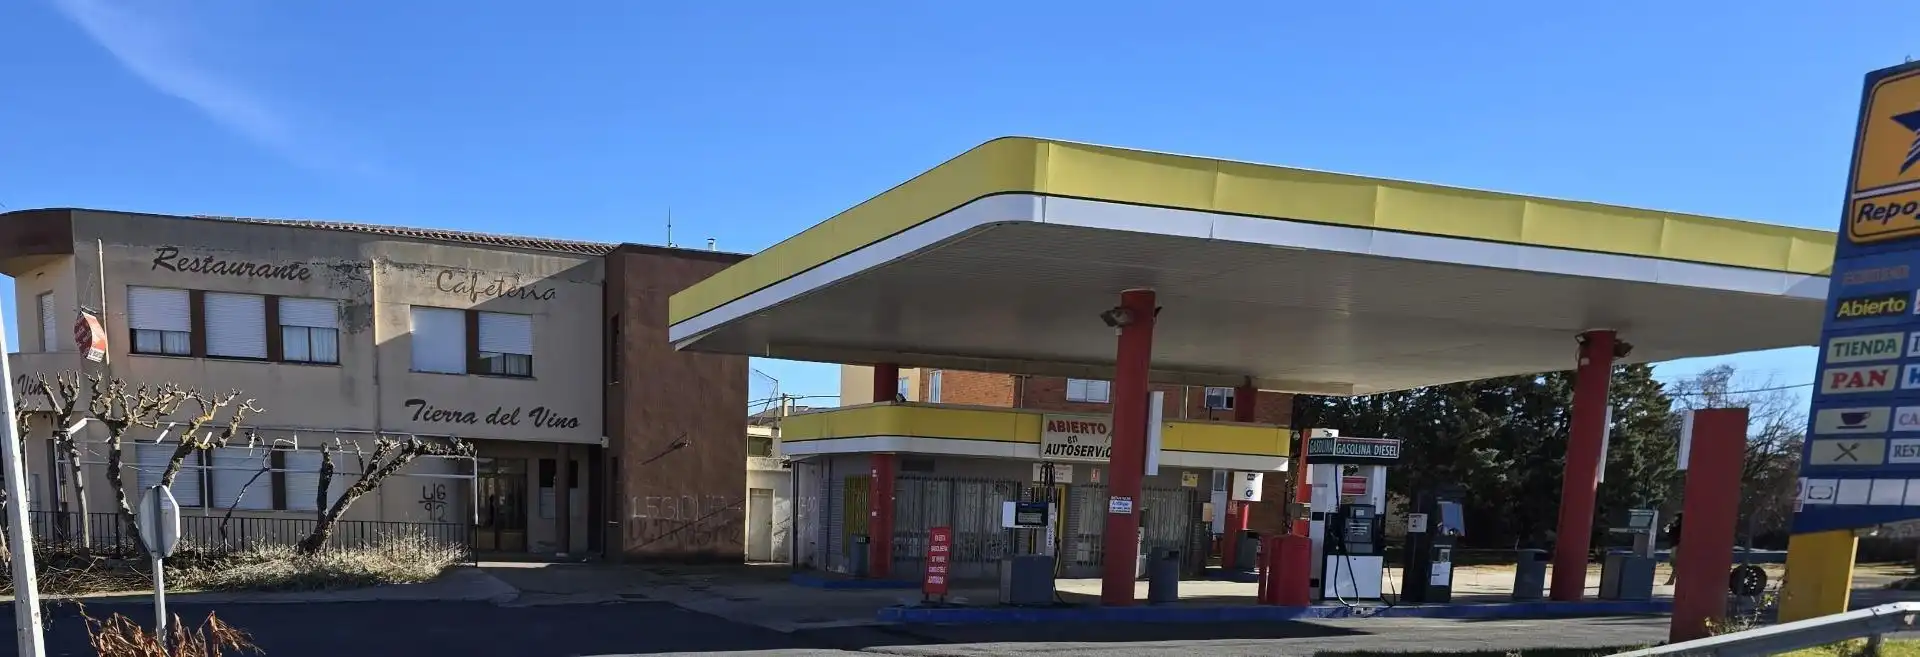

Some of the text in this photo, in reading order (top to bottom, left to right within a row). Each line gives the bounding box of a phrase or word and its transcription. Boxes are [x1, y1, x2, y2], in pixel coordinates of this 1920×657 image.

[151, 246, 311, 281] Restaurante
[1836, 298, 1906, 318] Abierto
[1833, 338, 1897, 358] TIENDA
[1830, 369, 1889, 390] PAN
[404, 398, 581, 429] Tierra del Vino
[1047, 420, 1107, 435] ABIERTO
[1067, 435, 1078, 444] en
[1309, 440, 1334, 454] GASOLINA
[1336, 443, 1397, 457] GASOLINA DIESEL
